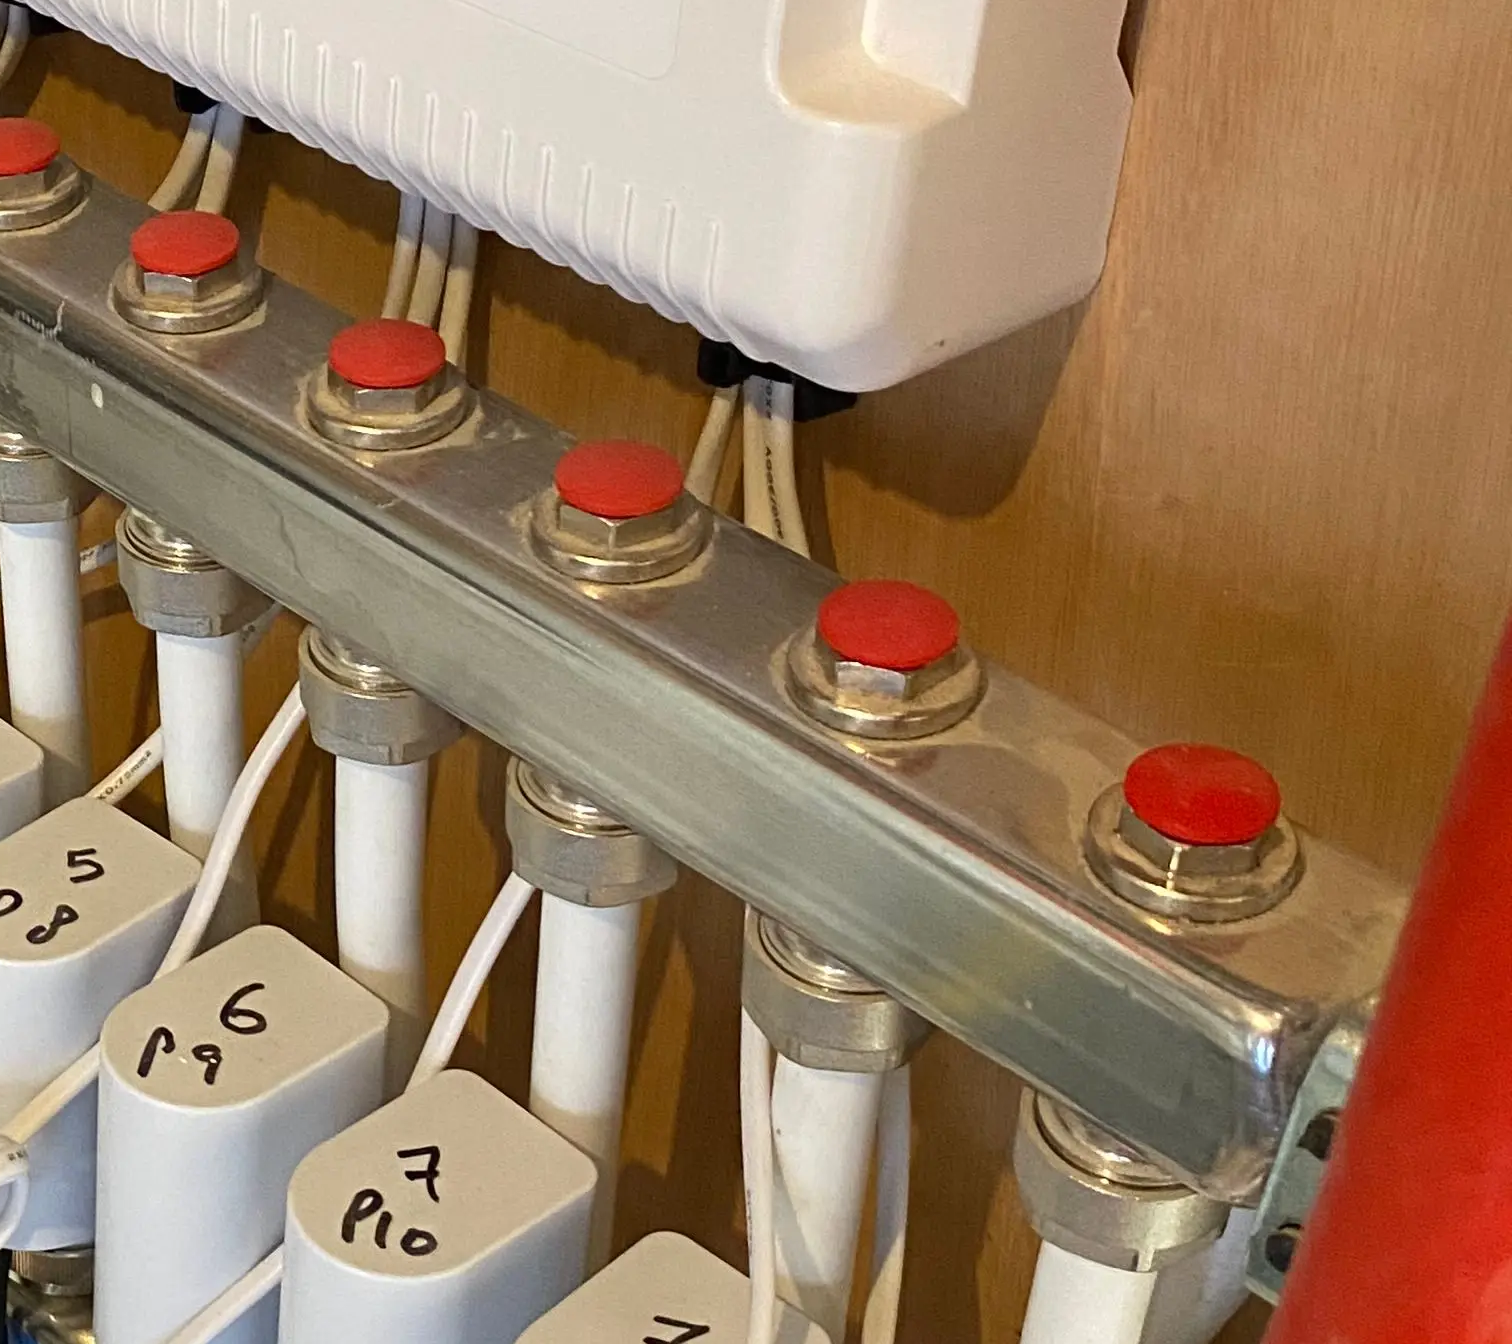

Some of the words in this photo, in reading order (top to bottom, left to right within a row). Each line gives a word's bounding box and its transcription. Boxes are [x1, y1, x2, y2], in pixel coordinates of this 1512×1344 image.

[66, 846, 105, 884] 5
[218, 981, 268, 1037] 6
[136, 1025, 223, 1086] P9
[397, 1144, 441, 1202] 7
[340, 1187, 439, 1258] P10
